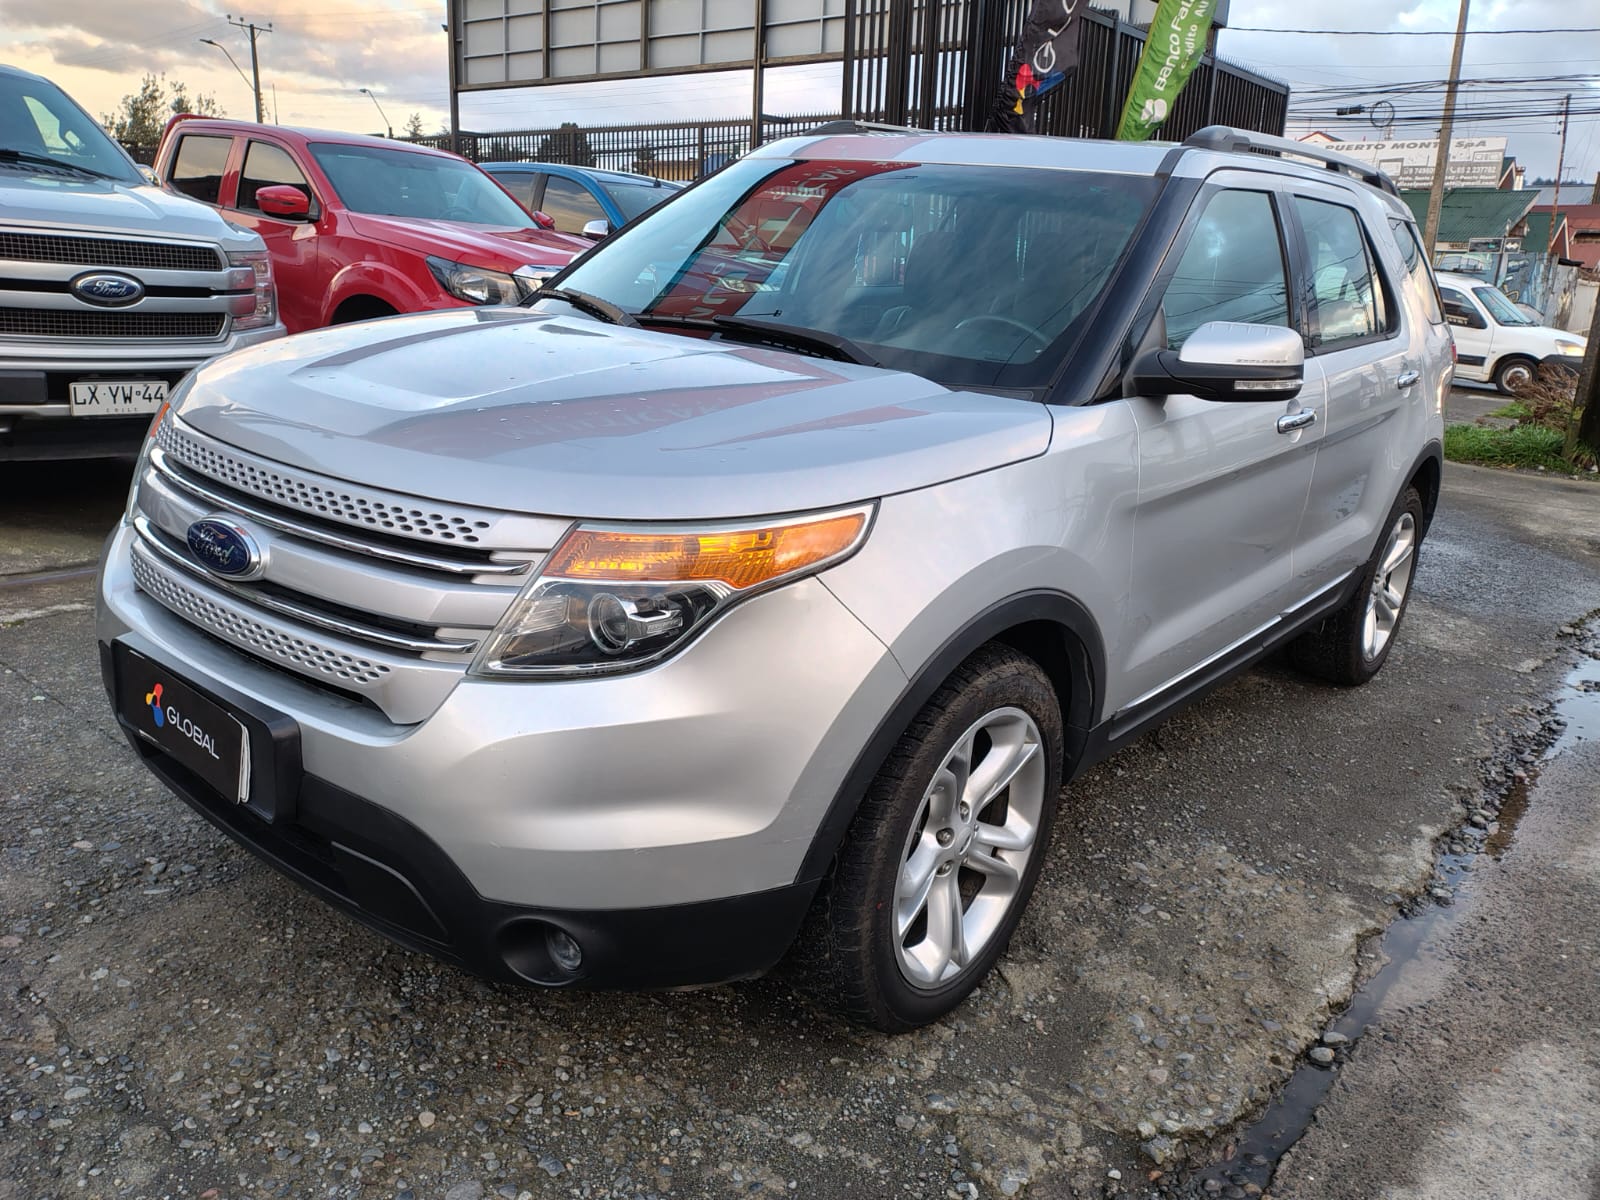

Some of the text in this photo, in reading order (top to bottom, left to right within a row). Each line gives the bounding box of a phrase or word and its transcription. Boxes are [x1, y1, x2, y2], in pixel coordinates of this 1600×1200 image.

[1154, 33, 1181, 91] Banco
[1325, 140, 1487, 151] PUERTO MONT SpA
[93, 279, 128, 297] Ford
[188, 524, 236, 567] Ford
[166, 705, 220, 760] GLOBAL
